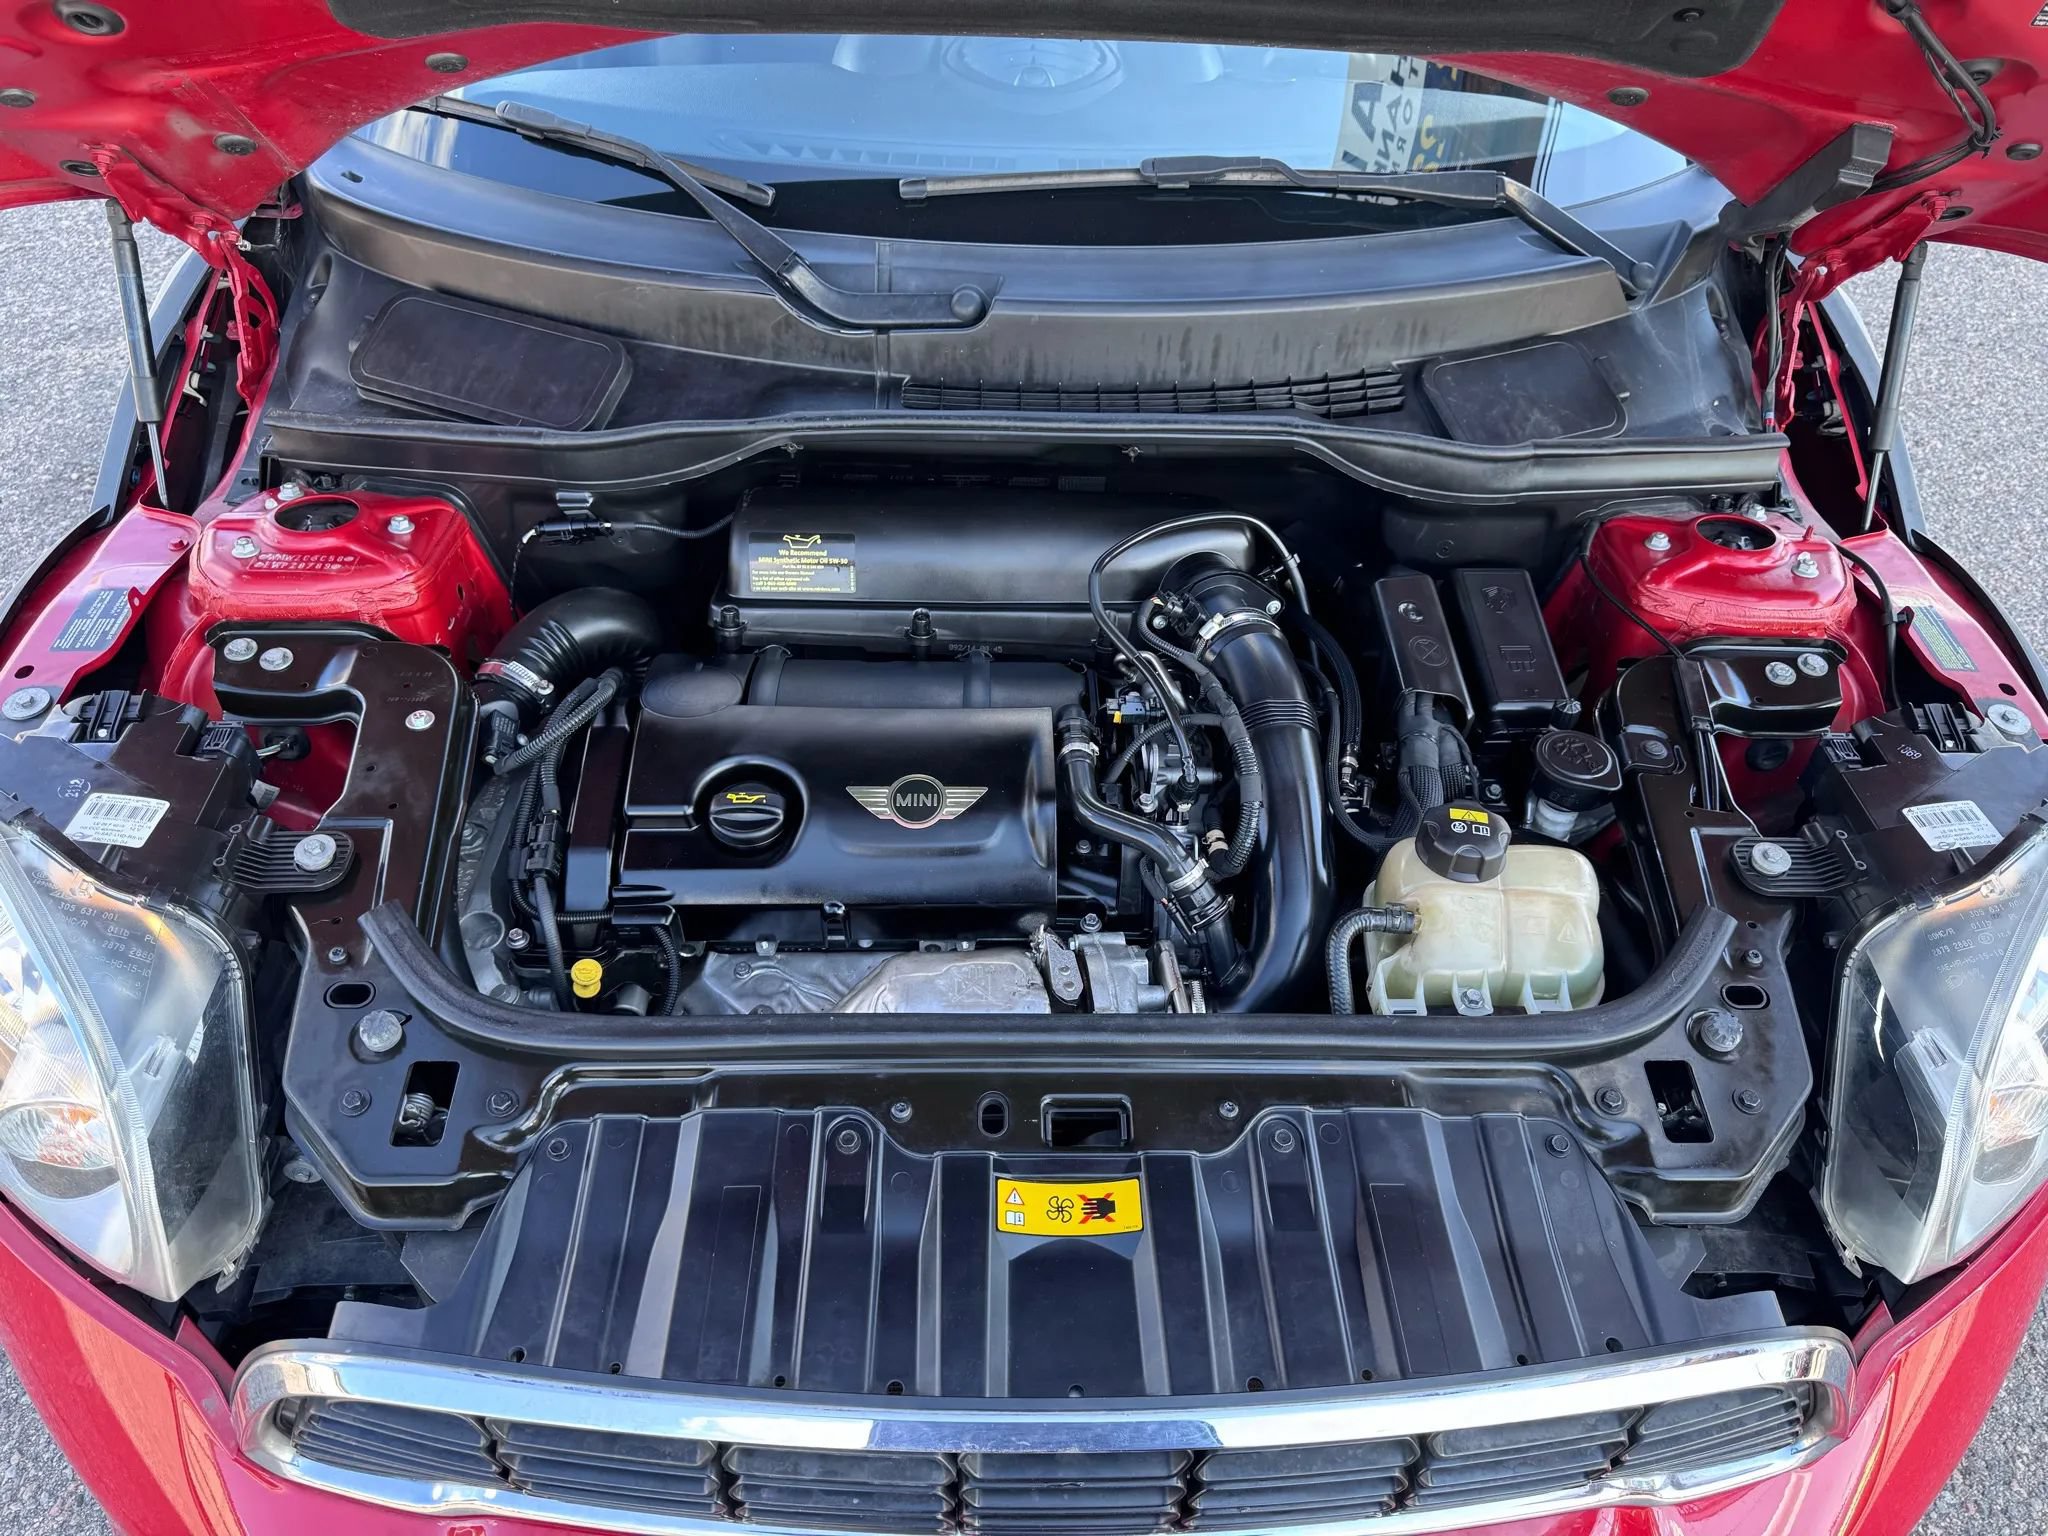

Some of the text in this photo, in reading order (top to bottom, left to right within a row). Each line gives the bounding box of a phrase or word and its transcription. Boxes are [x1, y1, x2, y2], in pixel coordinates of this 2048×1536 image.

[773, 557, 801, 565] Synthetic
[896, 793, 938, 807] MINI
[58, 902, 76, 912] 305
[80, 904, 97, 917] 631
[144, 934, 157, 945] PL
[101, 940, 126, 952] 2879
